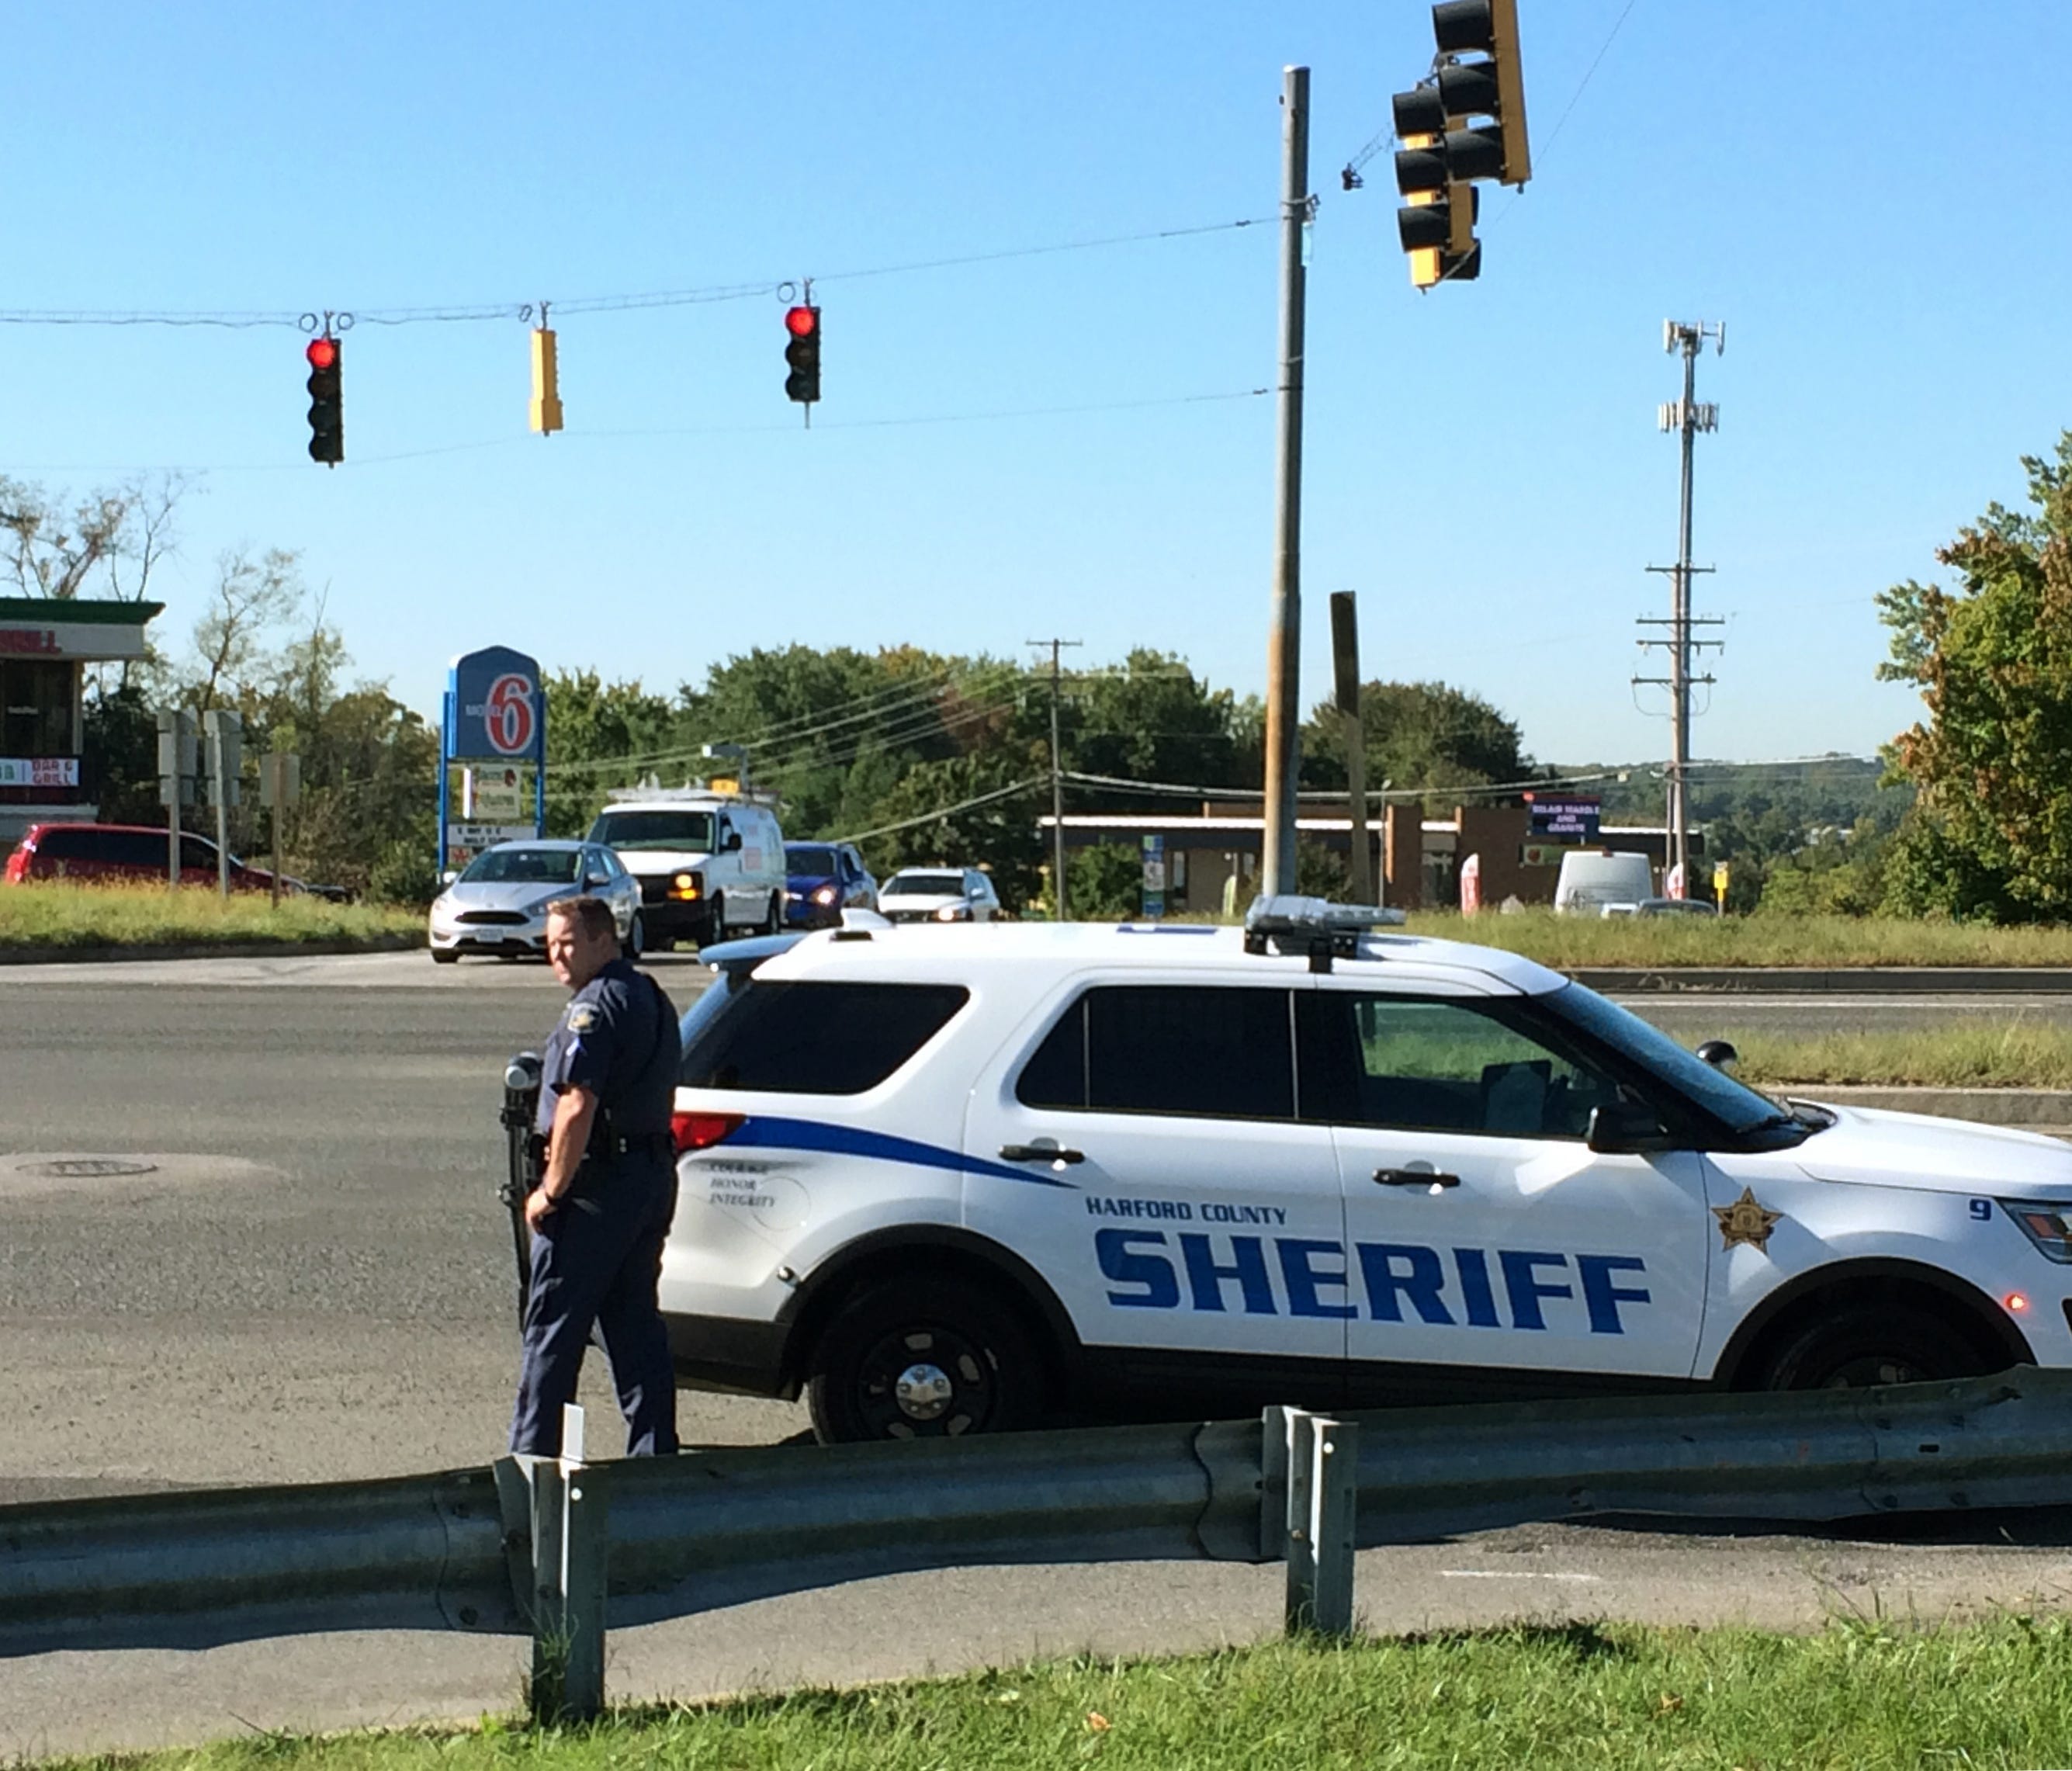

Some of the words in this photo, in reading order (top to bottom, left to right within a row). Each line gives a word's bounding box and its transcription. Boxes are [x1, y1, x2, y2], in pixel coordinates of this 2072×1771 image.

[485, 673, 535, 755] 6
[710, 1178, 757, 1191] HONOR
[709, 1193, 775, 1208] INTEGRITY
[1086, 1197, 1192, 1221] HARFORD
[1201, 1203, 1287, 1226] COUNTY
[1970, 1198, 1992, 1222] 9
[1094, 1227, 1651, 1335] SHERIFF
